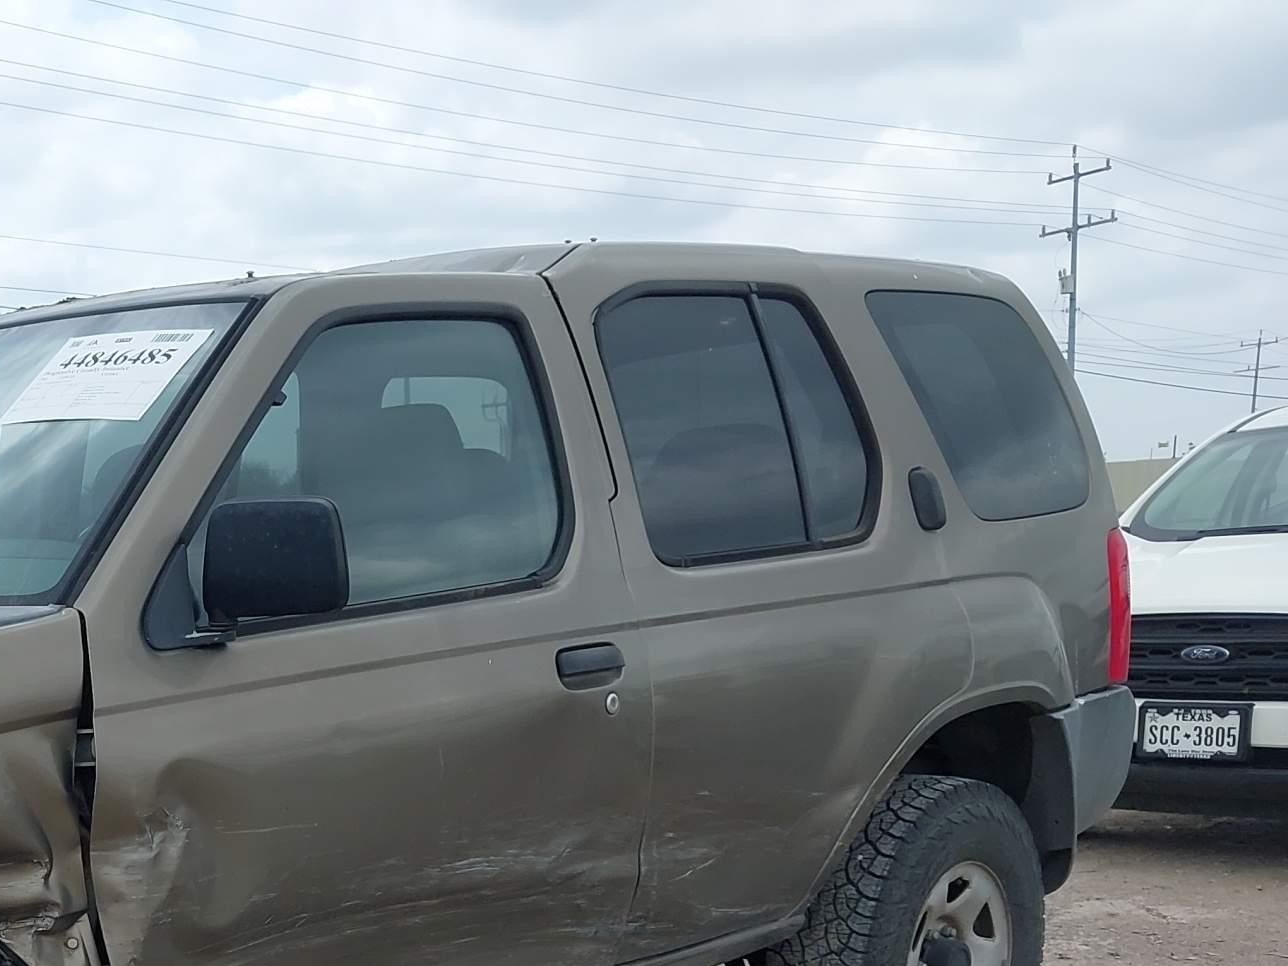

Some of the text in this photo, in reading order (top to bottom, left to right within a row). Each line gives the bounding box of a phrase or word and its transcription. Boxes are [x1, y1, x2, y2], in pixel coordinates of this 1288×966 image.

[60, 348, 178, 369] 44846485
[1174, 712, 1213, 722] TEXAS
[1148, 725, 1237, 748] SCC 3805
